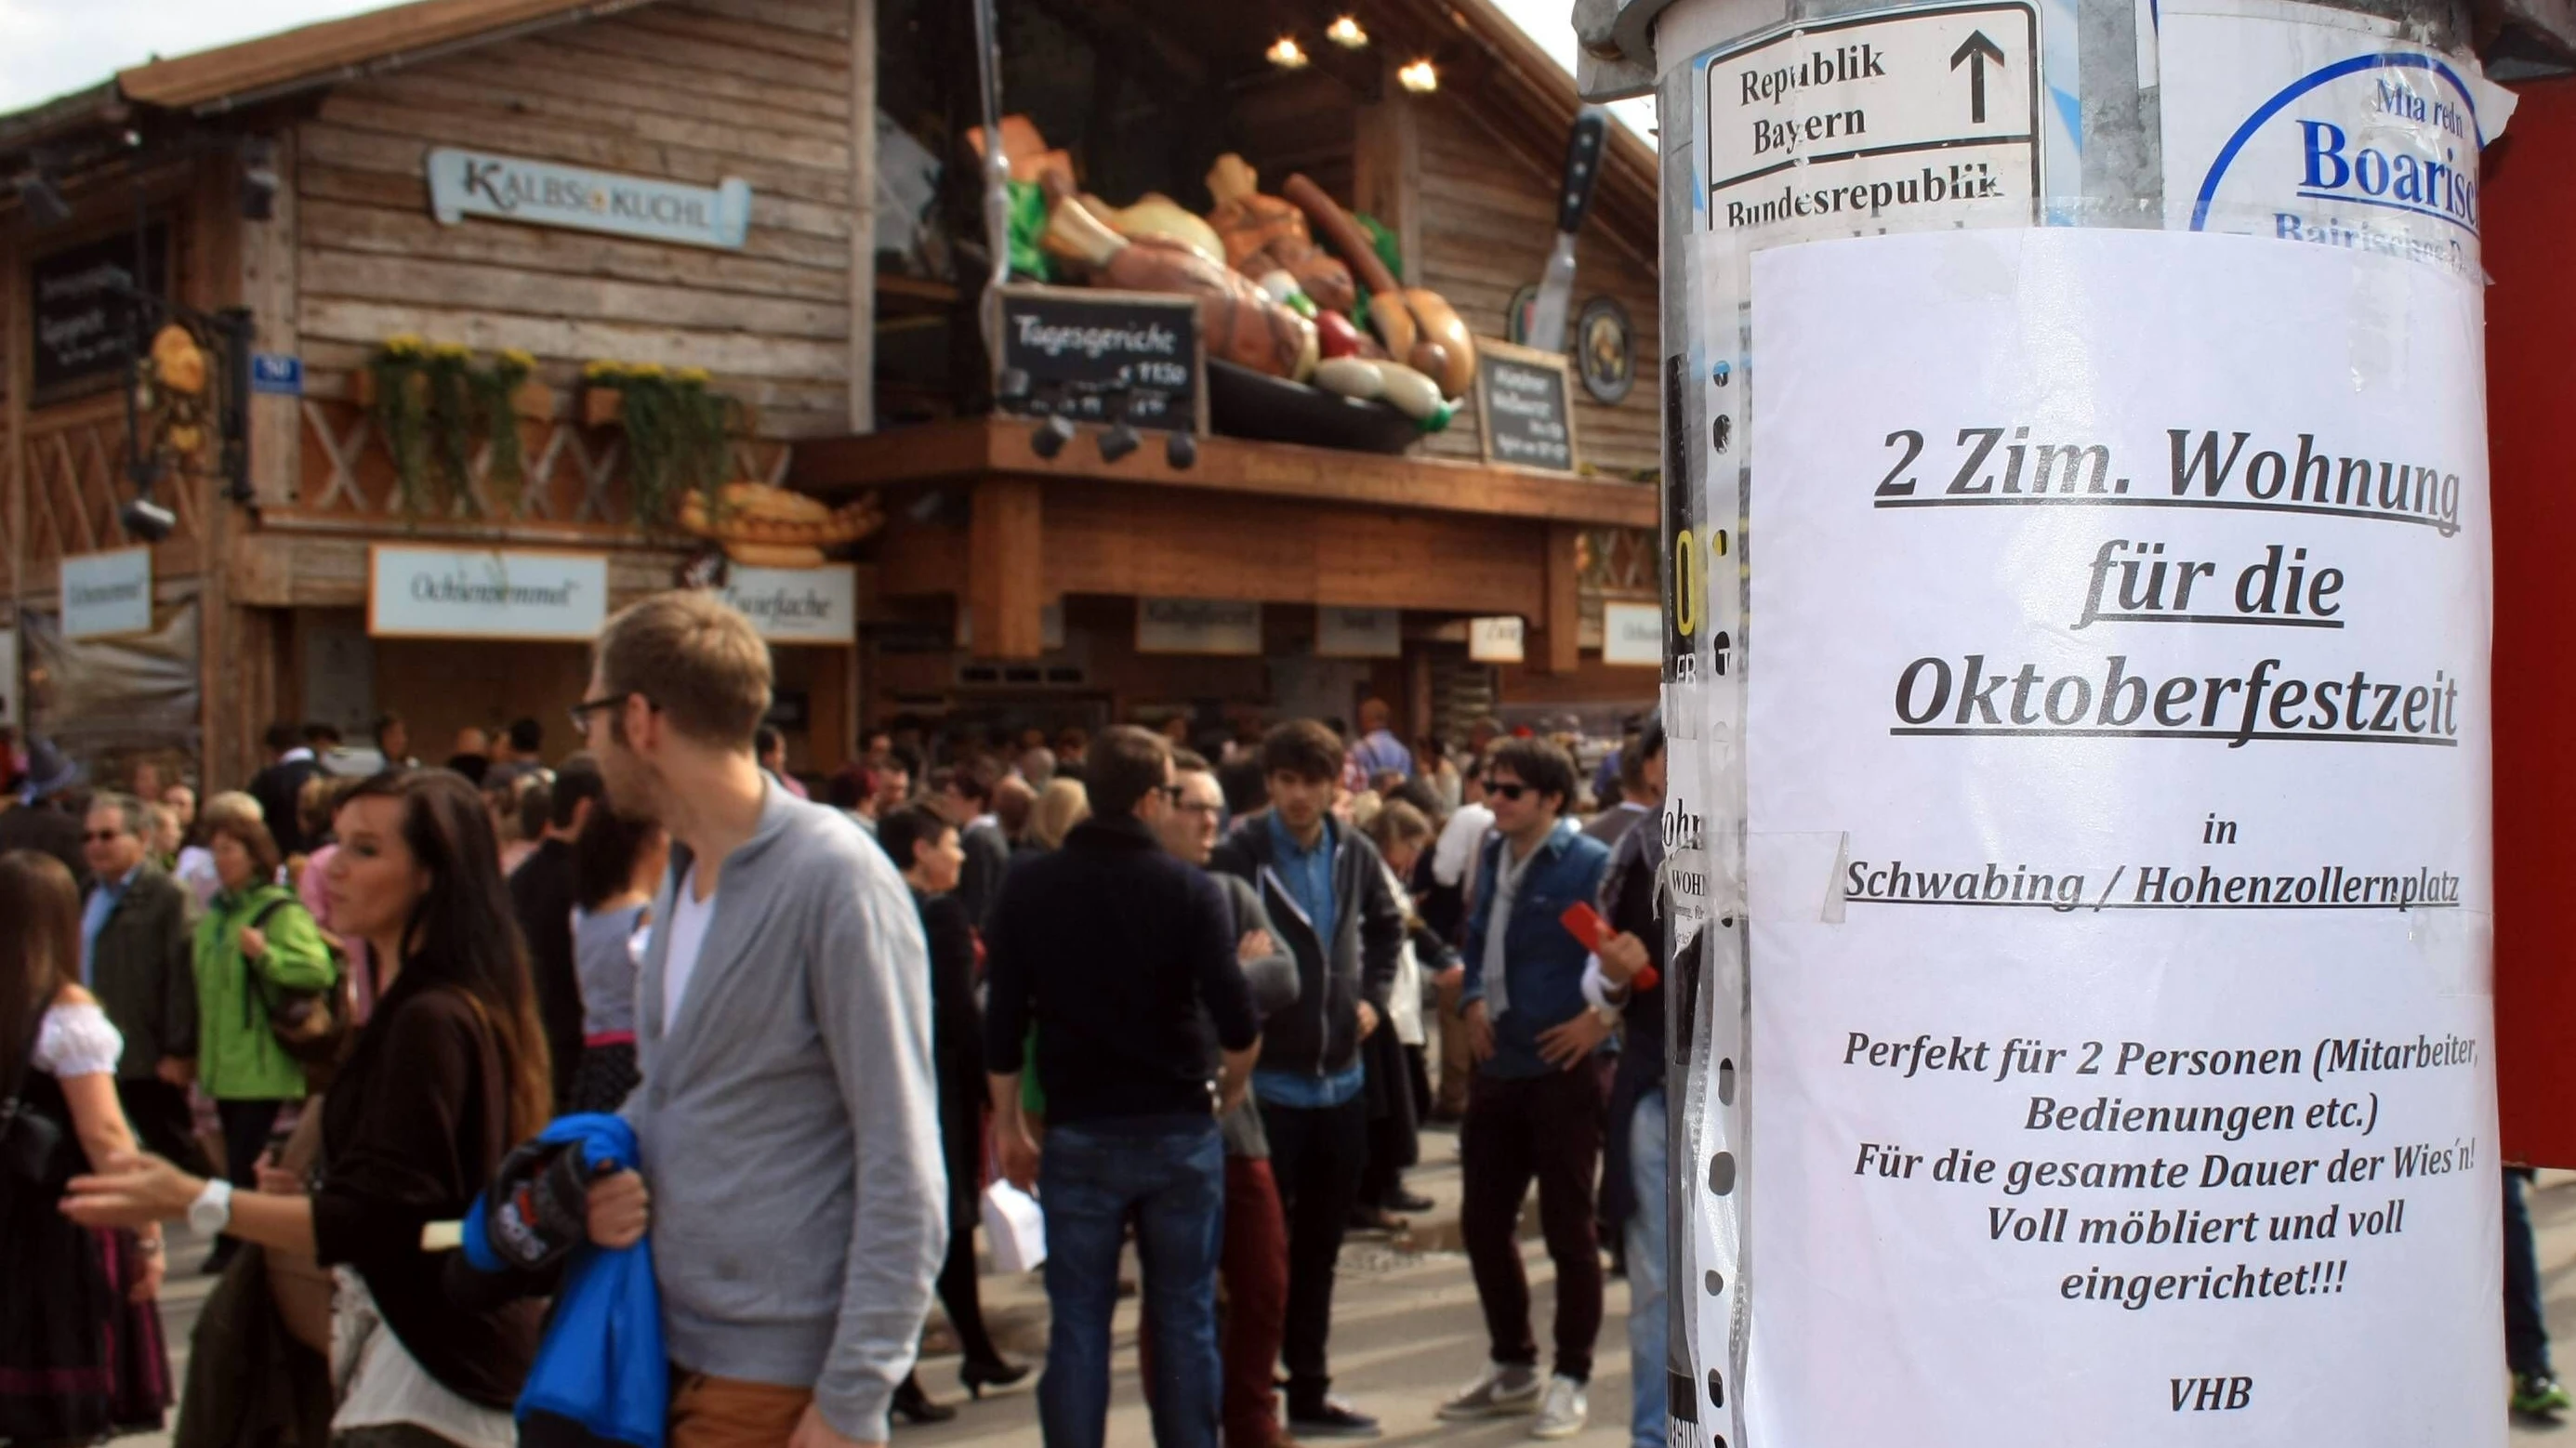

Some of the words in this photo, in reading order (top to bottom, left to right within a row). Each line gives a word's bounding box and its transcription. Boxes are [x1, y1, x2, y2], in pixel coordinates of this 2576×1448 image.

[1740, 44, 1885, 107] Republik
[1753, 108, 1866, 156] Bayern
[2376, 78, 2425, 123] Mia
[2433, 100, 2464, 138] redn
[1875, 429, 1924, 497] 2
[1946, 427, 2130, 494] Zim.
[2167, 429, 2461, 537] Wohnung
[2070, 539, 2215, 629] für
[2234, 545, 2345, 618] die
[1895, 654, 2459, 748] Oktoberfestzeit
[2203, 812, 2238, 844] in
[1845, 861, 2085, 912] Schwabing
[2094, 864, 2126, 913] /
[2136, 866, 2460, 912] Hohenzollernplatz
[1843, 1033, 1989, 1079] Perfekt
[1994, 1039, 2067, 1083] für
[2077, 1042, 2102, 1074] 2
[2115, 1042, 2302, 1076] Personen
[2313, 1033, 2479, 1083] (Mitarbeiter,
[2025, 1097, 2294, 1142] Bedienungen
[2305, 1092, 2379, 1137] etc.)
[1855, 1142, 1923, 1179] Für
[1933, 1148, 1996, 1184] die
[2003, 1154, 2189, 1196] gesamte
[2200, 1154, 2319, 1188] Dauer
[2327, 1148, 2385, 1183] der
[1988, 1206, 2067, 1243] Voll
[2080, 1209, 2260, 1244] möbliert
[2269, 1204, 2340, 1242] und
[2348, 1199, 2406, 1238] voll
[2061, 1260, 2348, 1310] eingerichtet!!!
[2170, 1376, 2253, 1412] VHB
